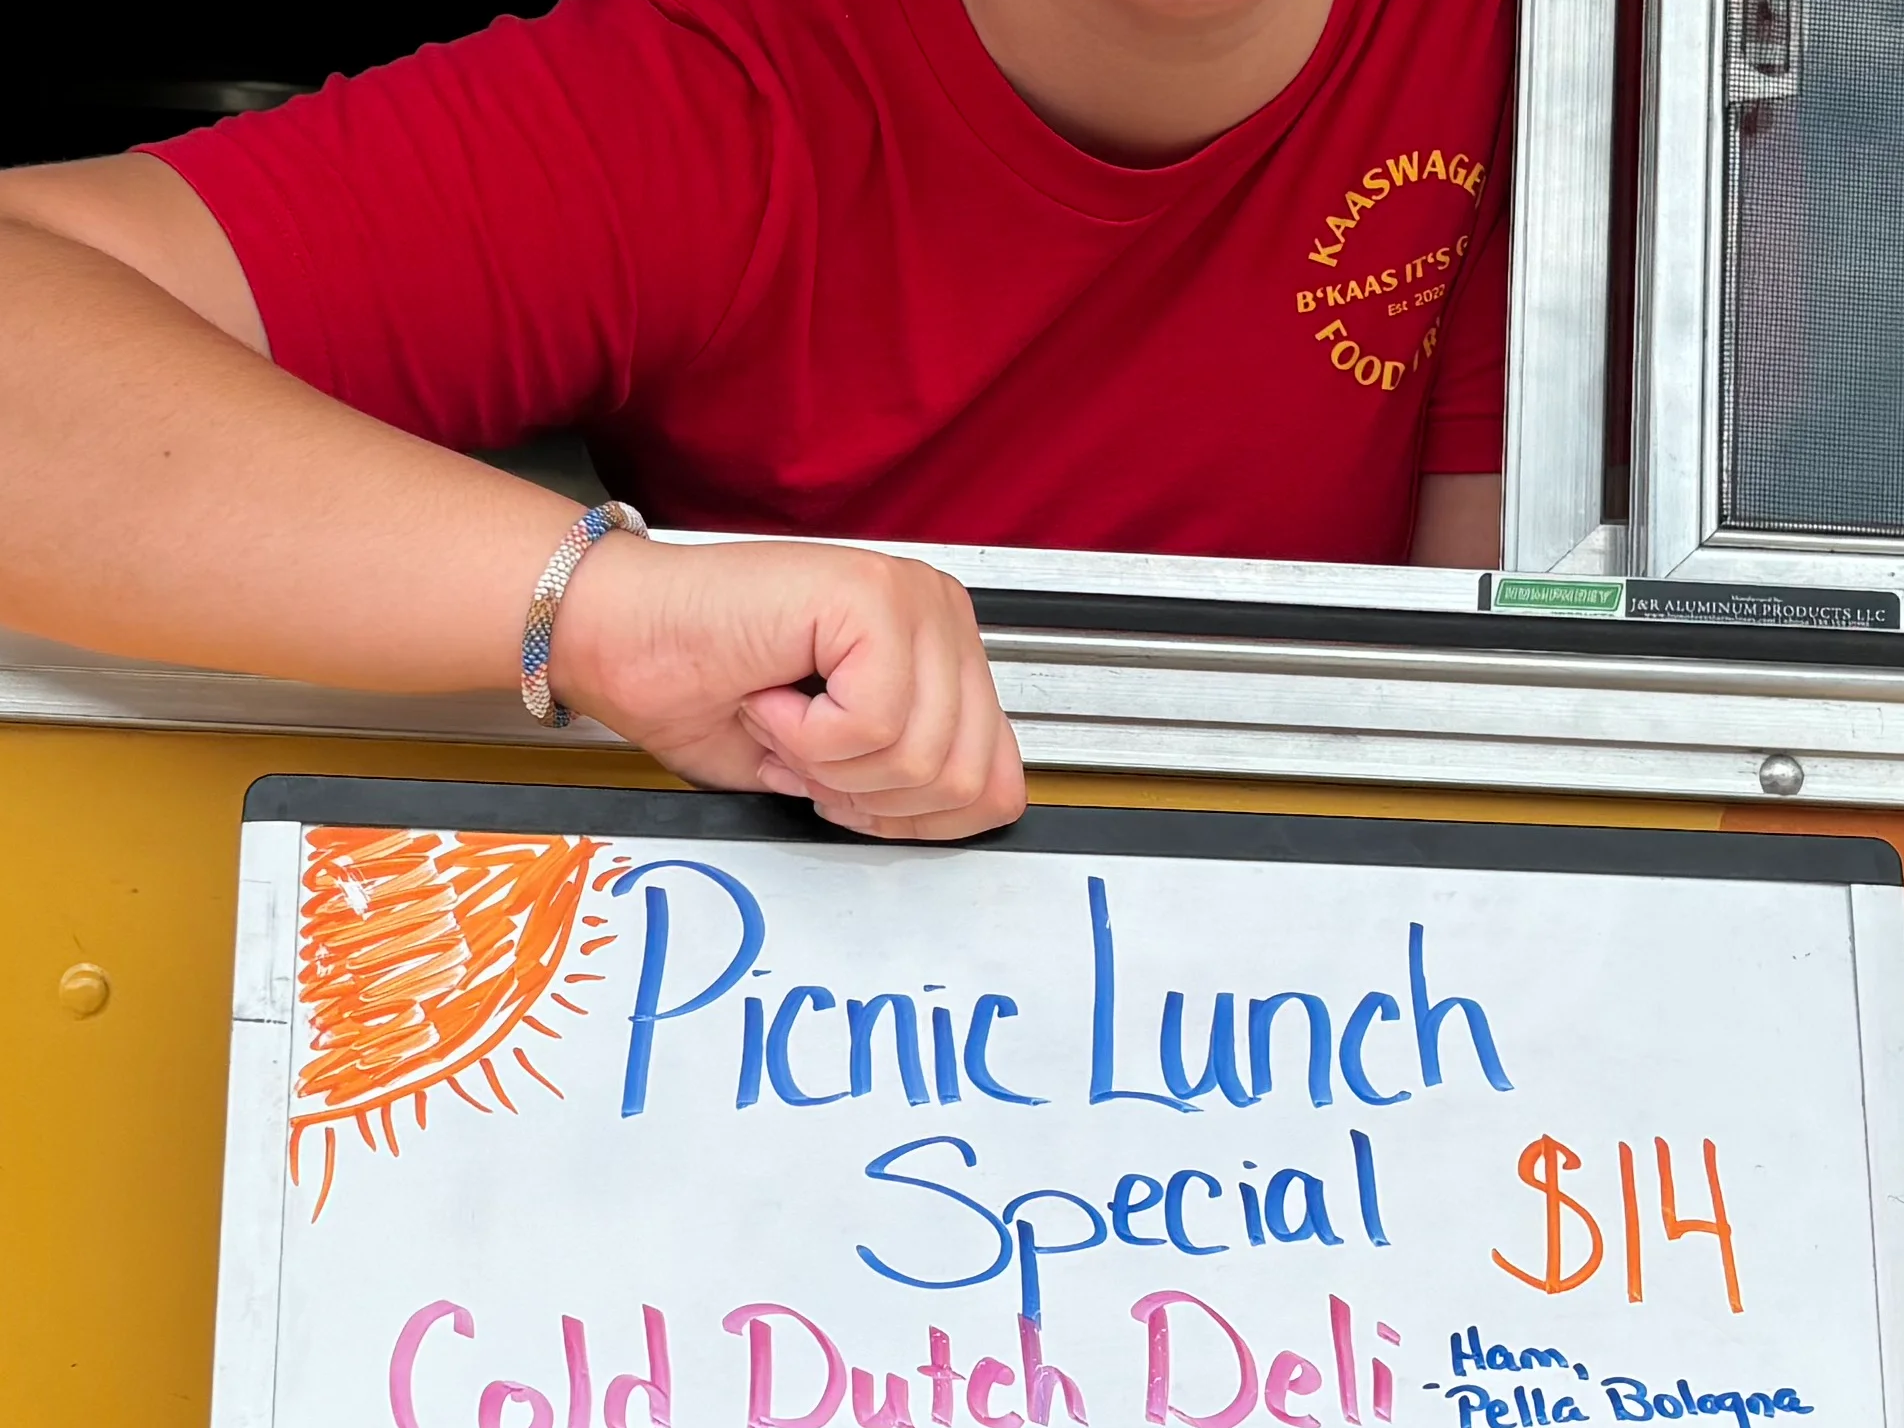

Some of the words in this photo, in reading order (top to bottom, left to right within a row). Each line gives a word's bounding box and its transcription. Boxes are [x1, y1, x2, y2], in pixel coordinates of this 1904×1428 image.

[1308, 149, 1486, 268] KAASWAGE
[1387, 300, 1409, 317] Est
[1315, 318, 1406, 391] FOOD
[1630, 597, 1659, 613] J&R
[1664, 599, 1758, 617] ALUMINUM
[1762, 603, 1852, 621] PRODUCTS
[1856, 608, 1887, 622] LLC
[613, 857, 1043, 1118] Picnic
[1089, 875, 1512, 1113] Lunch
[857, 1130, 1390, 1324] Special
[1491, 1134, 1744, 1314] $14
[1450, 1325, 1589, 1381] Ham,
